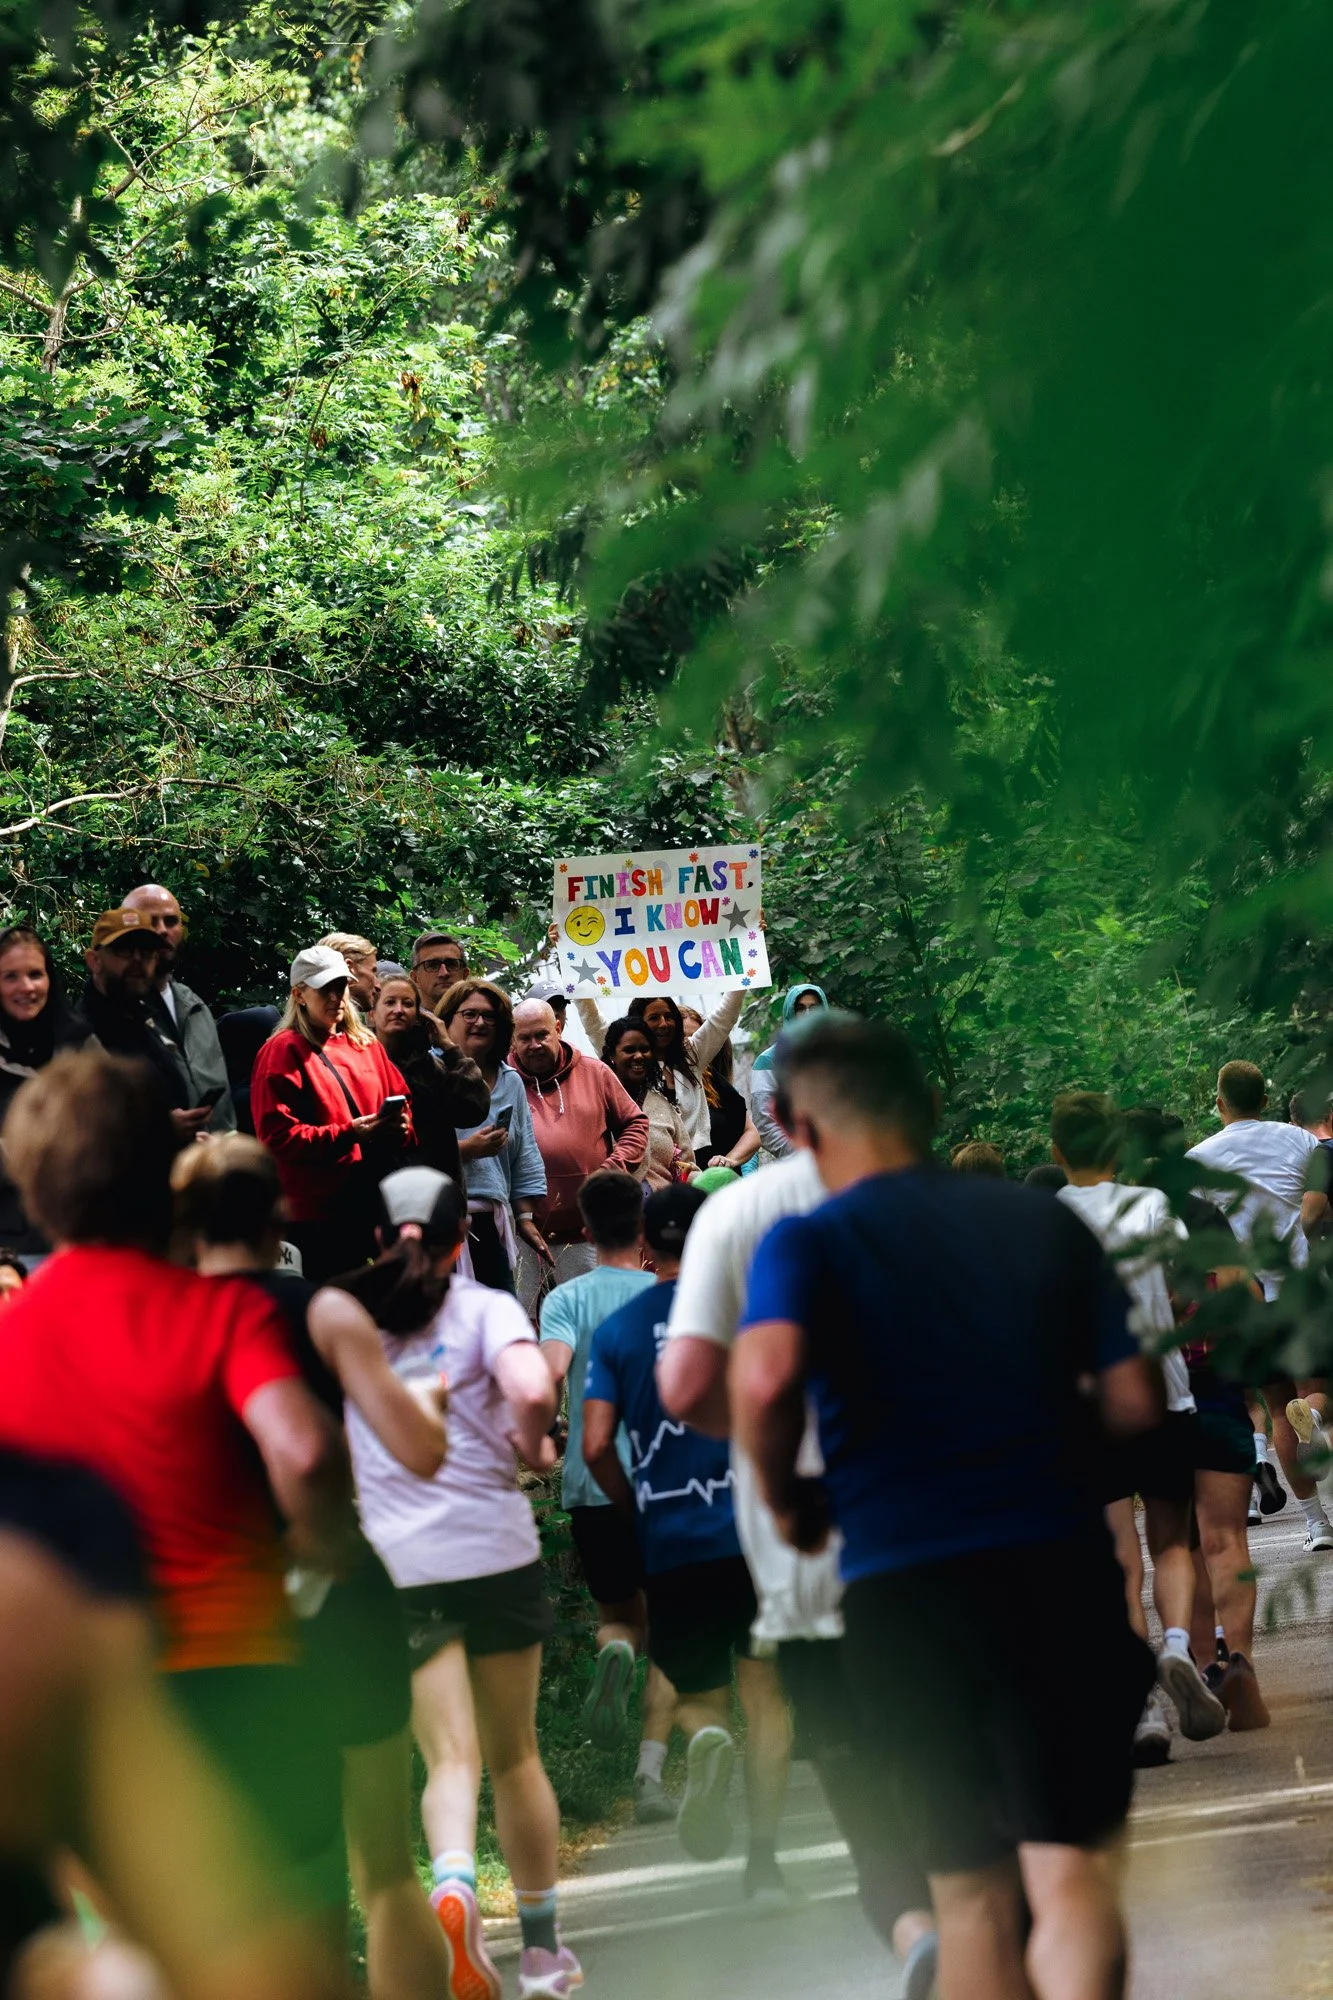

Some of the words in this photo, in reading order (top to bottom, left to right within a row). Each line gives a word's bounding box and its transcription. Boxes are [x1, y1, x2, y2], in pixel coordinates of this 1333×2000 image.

[567, 868, 663, 902] FINISH
[678, 860, 754, 894] FAST,
[614, 907, 636, 936] I
[646, 897, 720, 932] KNOW
[596, 945, 671, 987] YOU
[678, 937, 744, 980] CAN
